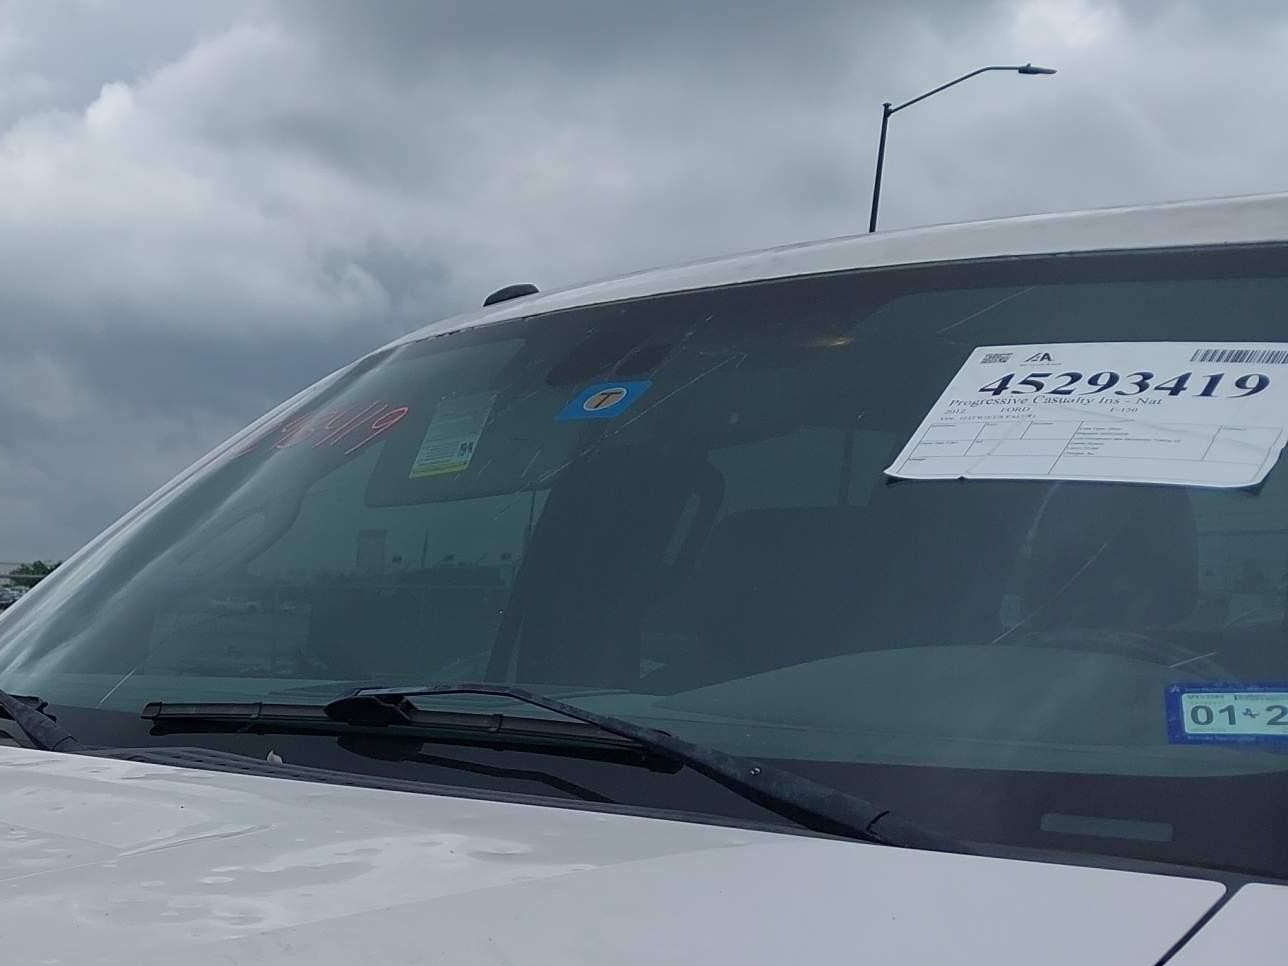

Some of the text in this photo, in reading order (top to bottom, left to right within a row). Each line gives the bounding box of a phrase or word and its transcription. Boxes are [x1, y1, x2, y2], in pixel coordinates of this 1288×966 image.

[978, 371, 1271, 399] 45293419
[595, 391, 622, 408] T
[949, 395, 1028, 408] Progressive
[1032, 395, 1091, 406] Casualty
[1098, 396, 1121, 405] Ins
[1136, 396, 1163, 405] Nat
